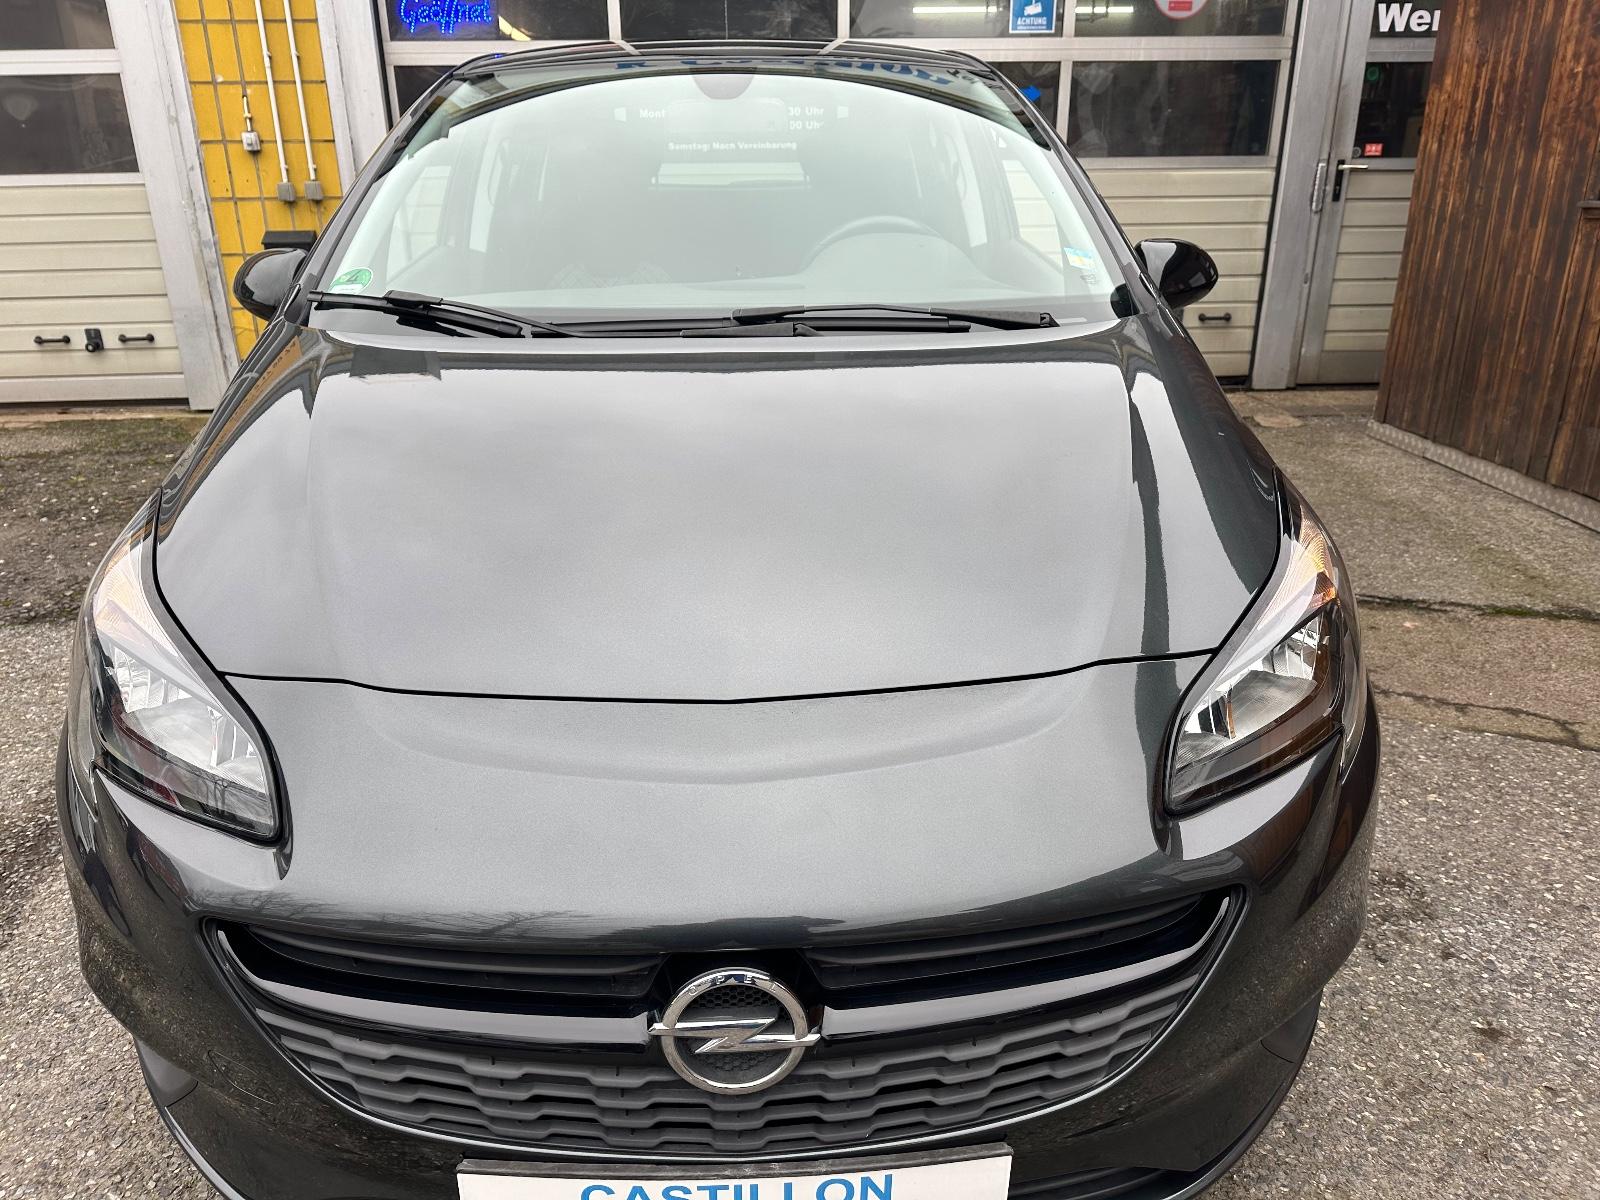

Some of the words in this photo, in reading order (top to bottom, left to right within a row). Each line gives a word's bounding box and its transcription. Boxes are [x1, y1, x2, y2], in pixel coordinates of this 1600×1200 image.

[1017, 16, 1047, 25] ACHTUNG
[805, 106, 824, 116] Uhr
[688, 974, 777, 996] OPEL
